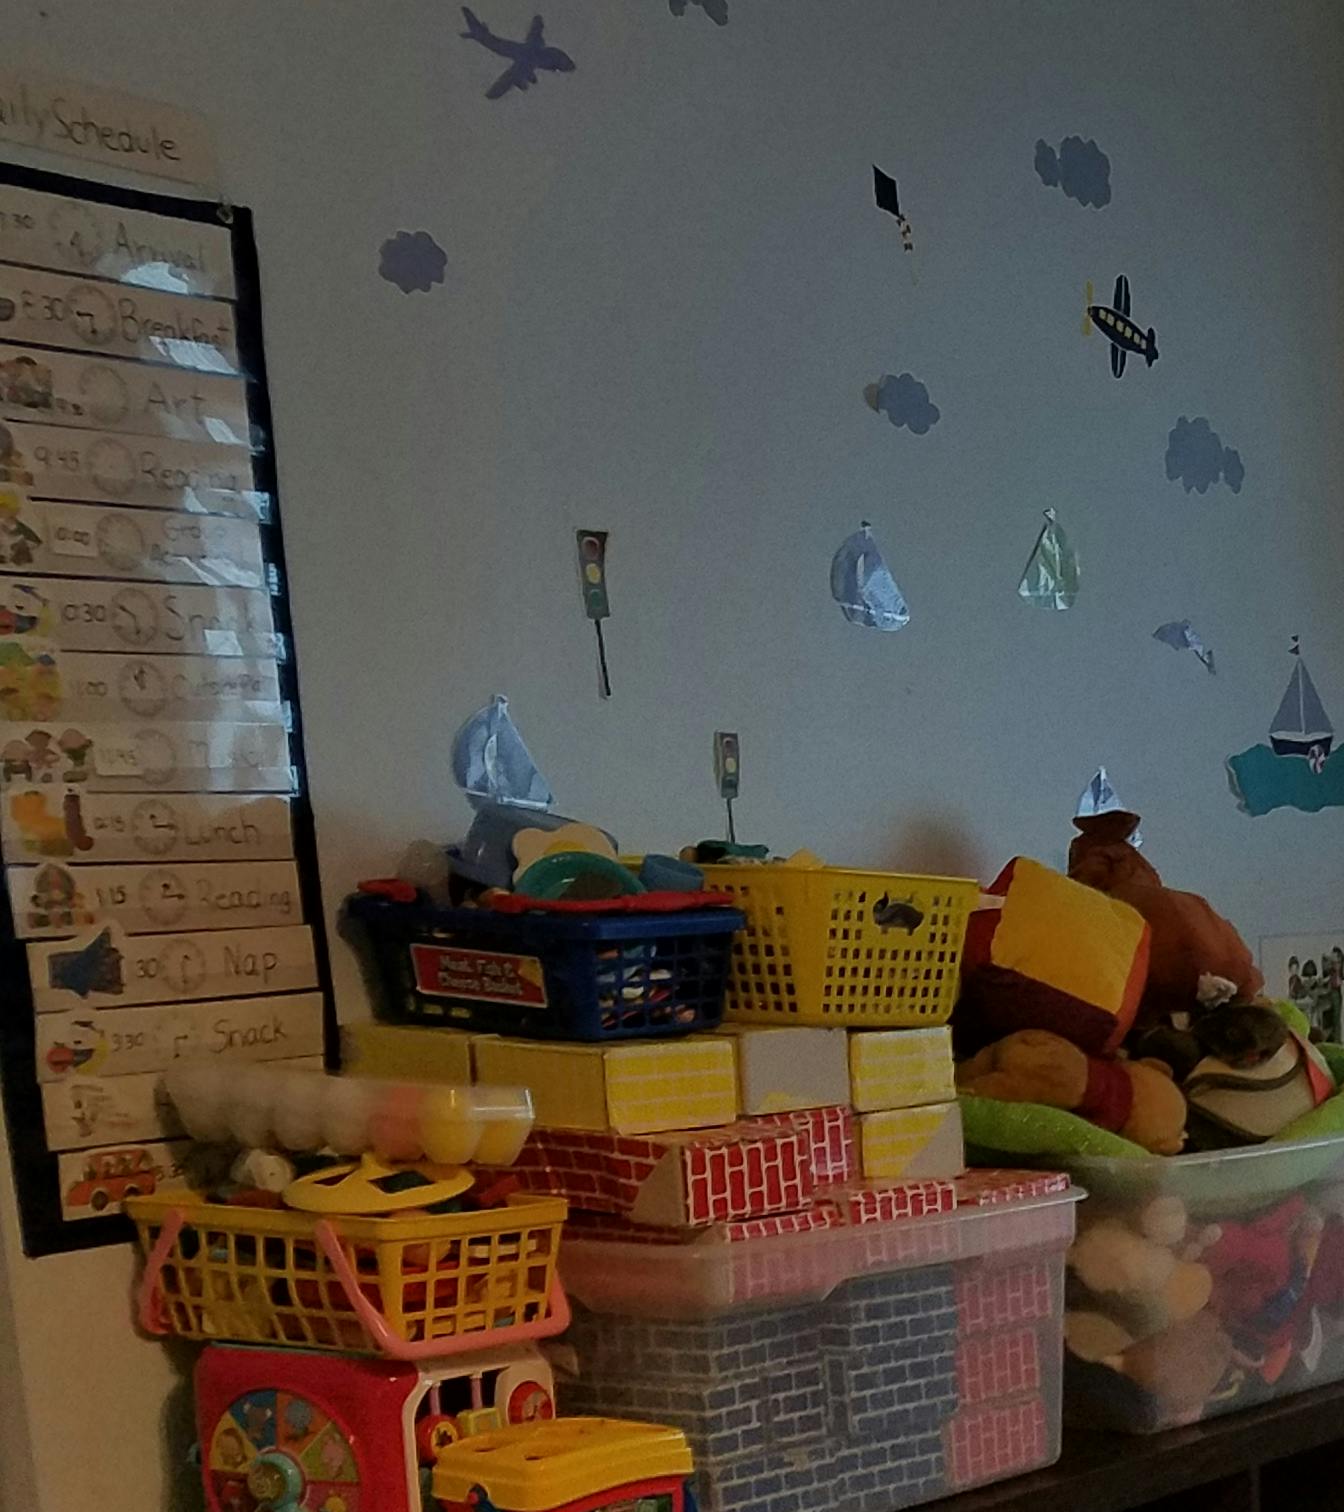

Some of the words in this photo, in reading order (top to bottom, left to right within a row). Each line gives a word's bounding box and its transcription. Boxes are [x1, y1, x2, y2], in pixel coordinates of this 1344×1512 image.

[143, 381, 208, 426] Art
[183, 803, 263, 846] Lunch
[220, 943, 279, 987] Nap
[208, 1017, 288, 1057] Snack
